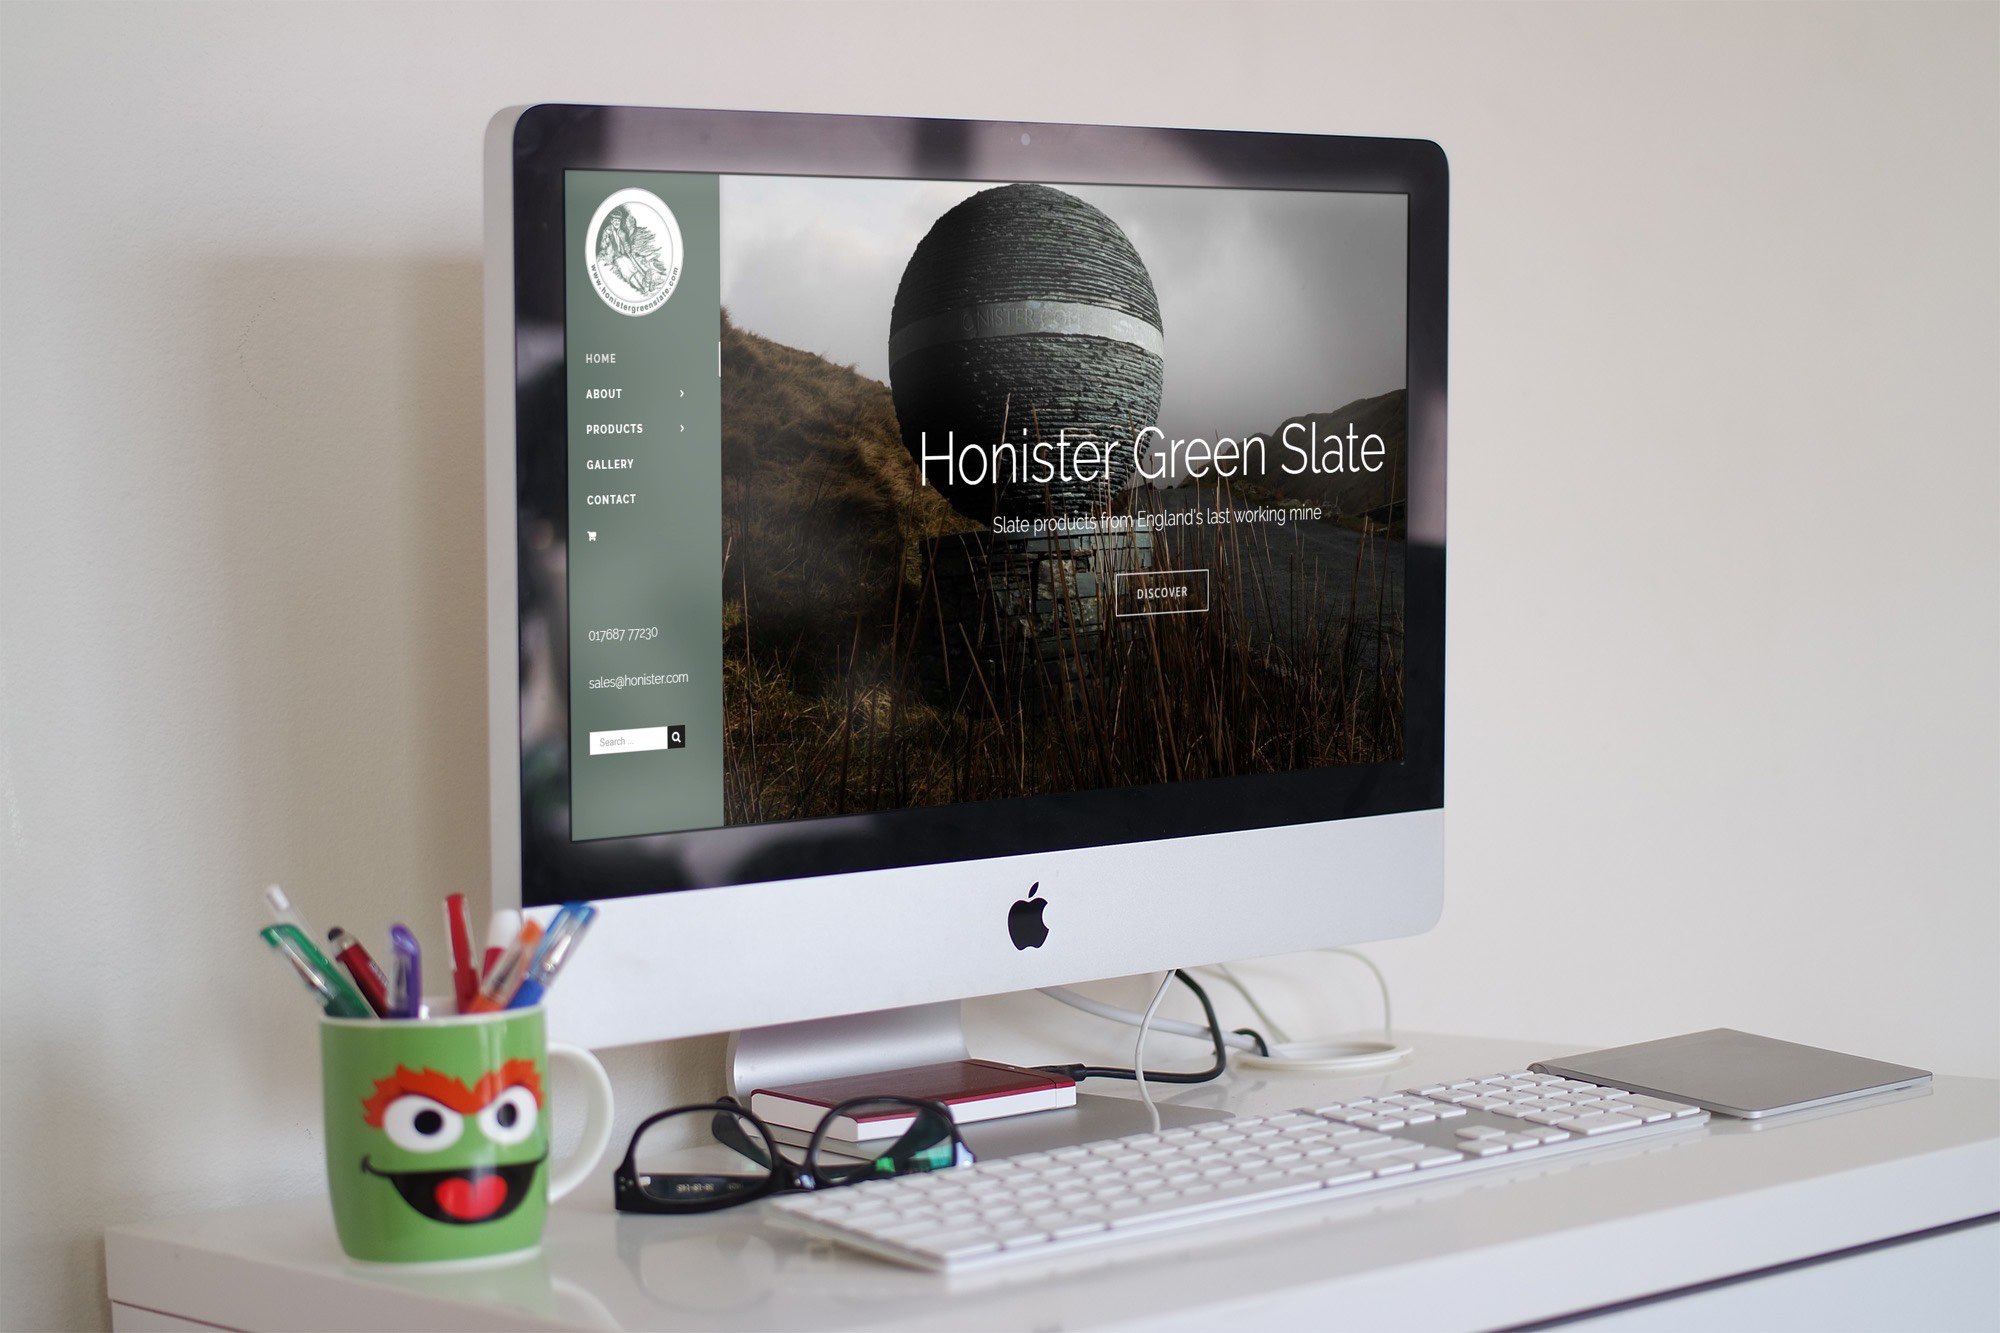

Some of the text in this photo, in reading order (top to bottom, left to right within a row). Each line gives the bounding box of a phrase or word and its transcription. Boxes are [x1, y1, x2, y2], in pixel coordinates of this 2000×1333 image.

[590, 263, 679, 314] www.honistergreenslate.com
[585, 353, 617, 364] HOME
[586, 388, 623, 399] ABOUT
[586, 423, 643, 435] PRODUCTS
[921, 421, 1386, 486] Honister Green Slate
[586, 458, 634, 470] GALLERY
[586, 493, 637, 505] CONTACT
[993, 503, 1322, 537] Slate products from England's last working mine
[1136, 586, 1188, 600] DISCOVER
[588, 626, 659, 643] 017687 77230
[588, 673, 689, 690] sales@honister.com
[599, 737, 626, 747] Search
